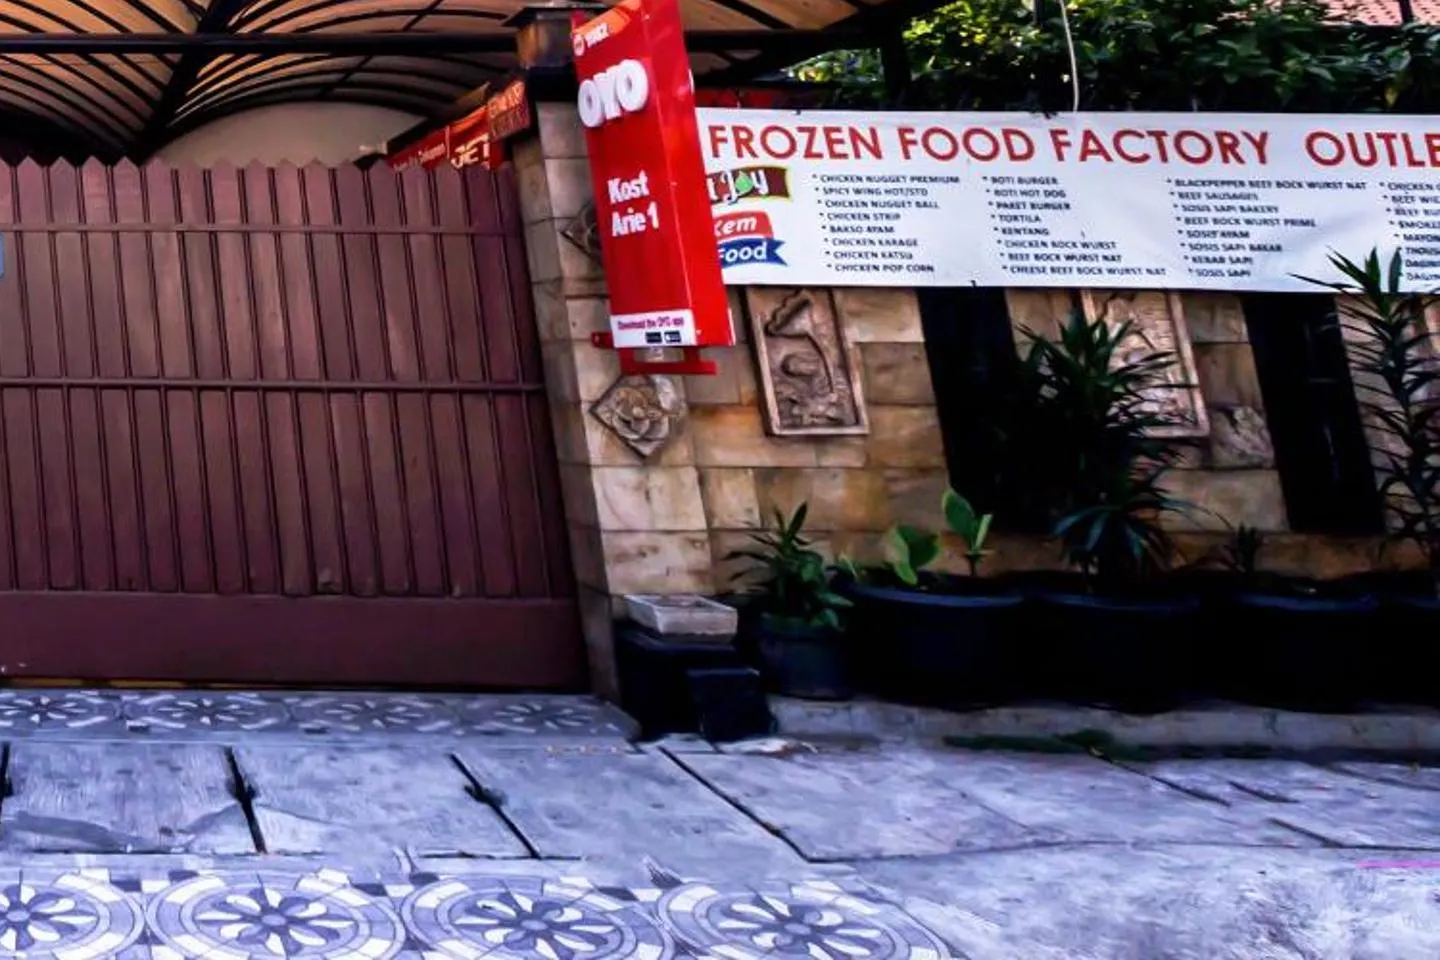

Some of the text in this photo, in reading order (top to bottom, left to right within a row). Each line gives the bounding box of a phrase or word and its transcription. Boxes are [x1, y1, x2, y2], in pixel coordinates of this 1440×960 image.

[578, 59, 649, 128] OYO
[708, 124, 883, 161] FROZEN
[896, 126, 1036, 163] FOOD
[1049, 128, 1269, 165] FACTORY
[820, 174, 863, 183] CHICKEN
[866, 175, 907, 183] NUGGET
[1017, 176, 1058, 185] BURGER
[607, 169, 650, 205] Kost
[823, 187, 850, 195] SPICY
[853, 187, 882, 196] WING
[1020, 189, 1040, 198] HOT
[1043, 190, 1066, 198] DOG
[1178, 192, 1201, 200] BEEF
[825, 200, 940, 209] CHICKEN NUGGET BALL
[1030, 202, 1070, 211] BURGER
[612, 201, 659, 237] Arie 1
[827, 213, 870, 221] CHICKEN
[998, 214, 1041, 223] TORTILA
[1184, 217, 1209, 225] BEEF
[1212, 217, 1241, 226] BOCK
[1244, 217, 1281, 226] WURST
[830, 225, 863, 233] BAKSO
[1001, 227, 1050, 236] KENTANG
[832, 238, 876, 246] CHICKEN
[1004, 240, 1048, 249] CHICKEN
[1080, 241, 1116, 249] WURST
[833, 251, 913, 260] CHICKEN KATSU
[1064, 254, 1099, 262] WURST
[835, 263, 934, 272] CHICKEN POP CORN
[1010, 266, 1048, 275] CHEESE
[1106, 267, 1143, 276] WURST
